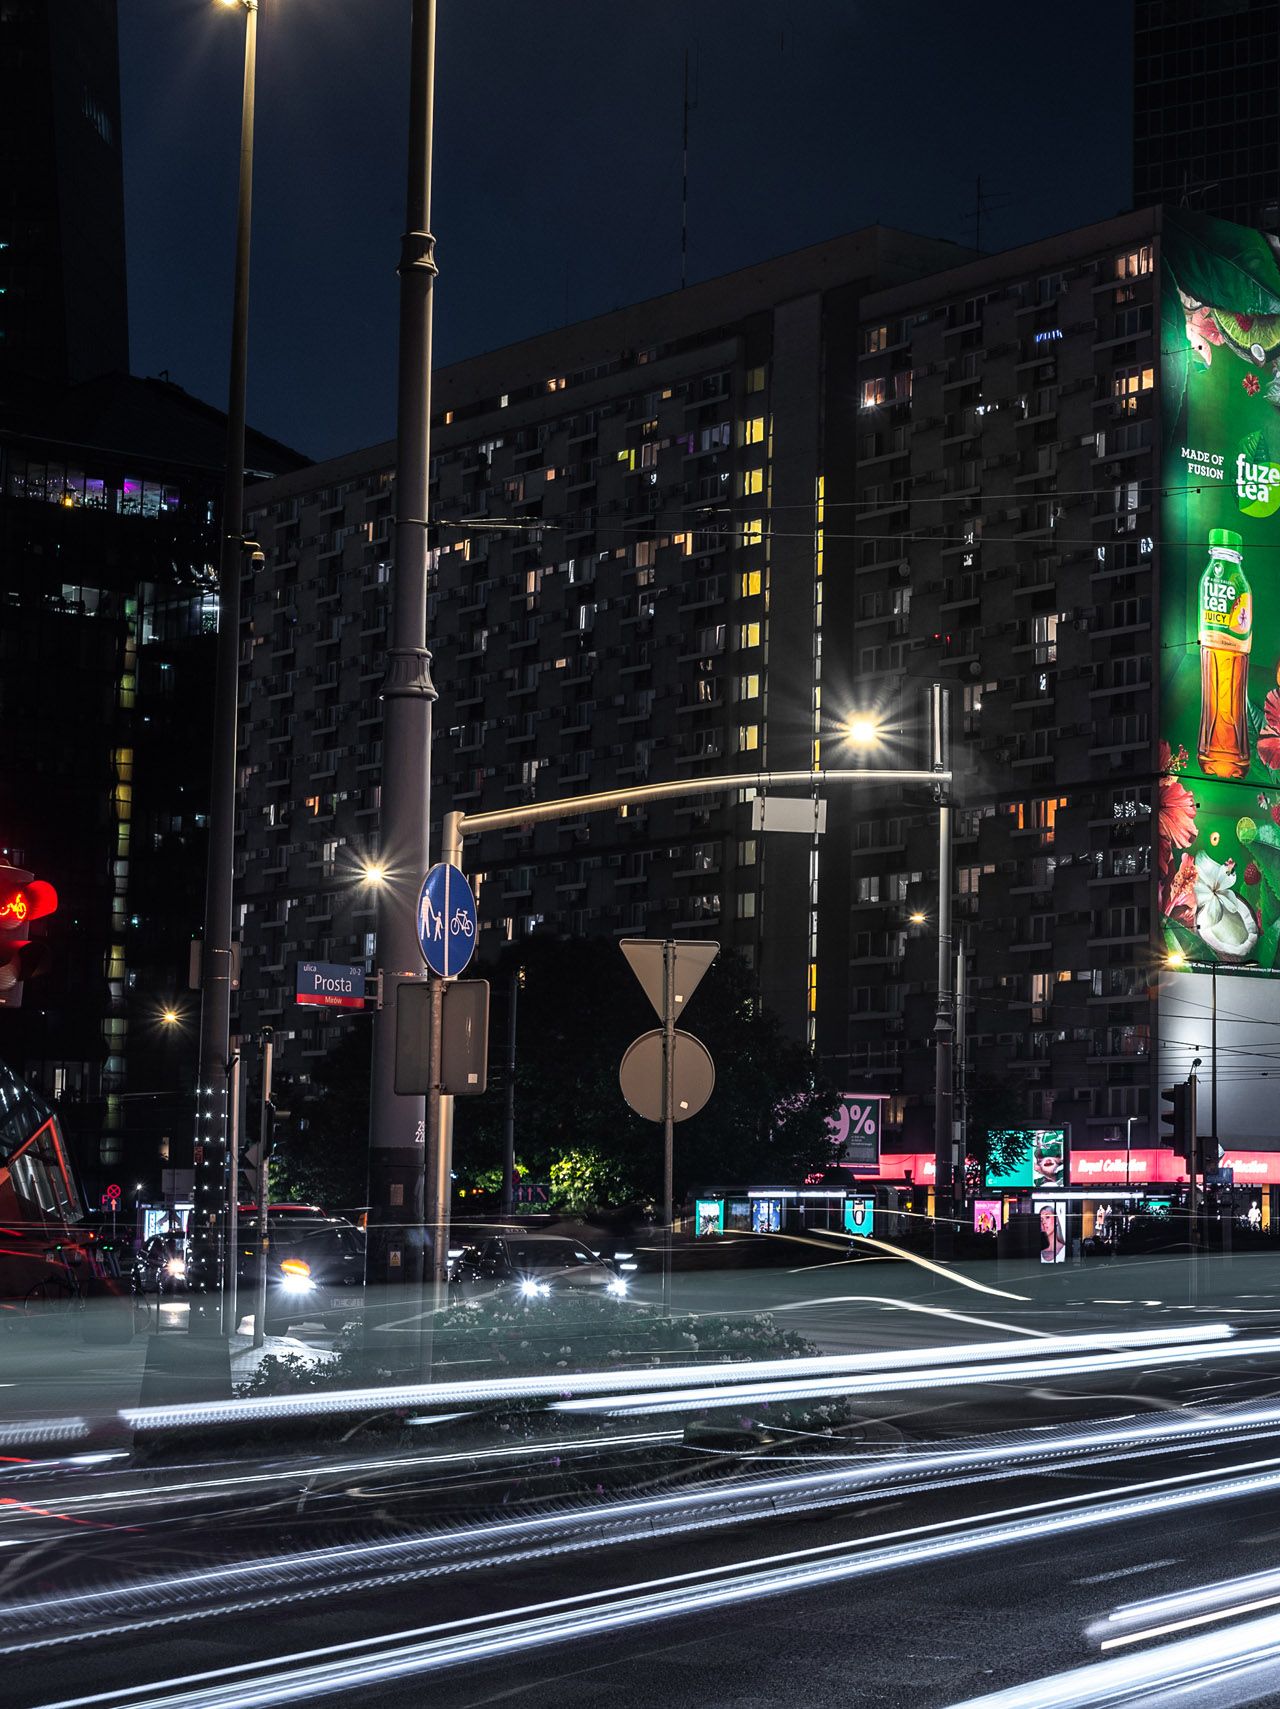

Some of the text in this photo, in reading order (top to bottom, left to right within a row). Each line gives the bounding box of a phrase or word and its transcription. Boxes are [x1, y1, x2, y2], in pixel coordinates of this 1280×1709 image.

[1181, 447, 1224, 466] MADE OF
[1187, 463, 1224, 481] FUSION
[1236, 453, 1280, 487] fuze
[1236, 478, 1269, 504] tea
[1204, 576, 1236, 601] fuze
[1204, 595, 1227, 613] tea
[304, 964, 317, 972] ulica
[314, 974, 352, 992] Prosta
